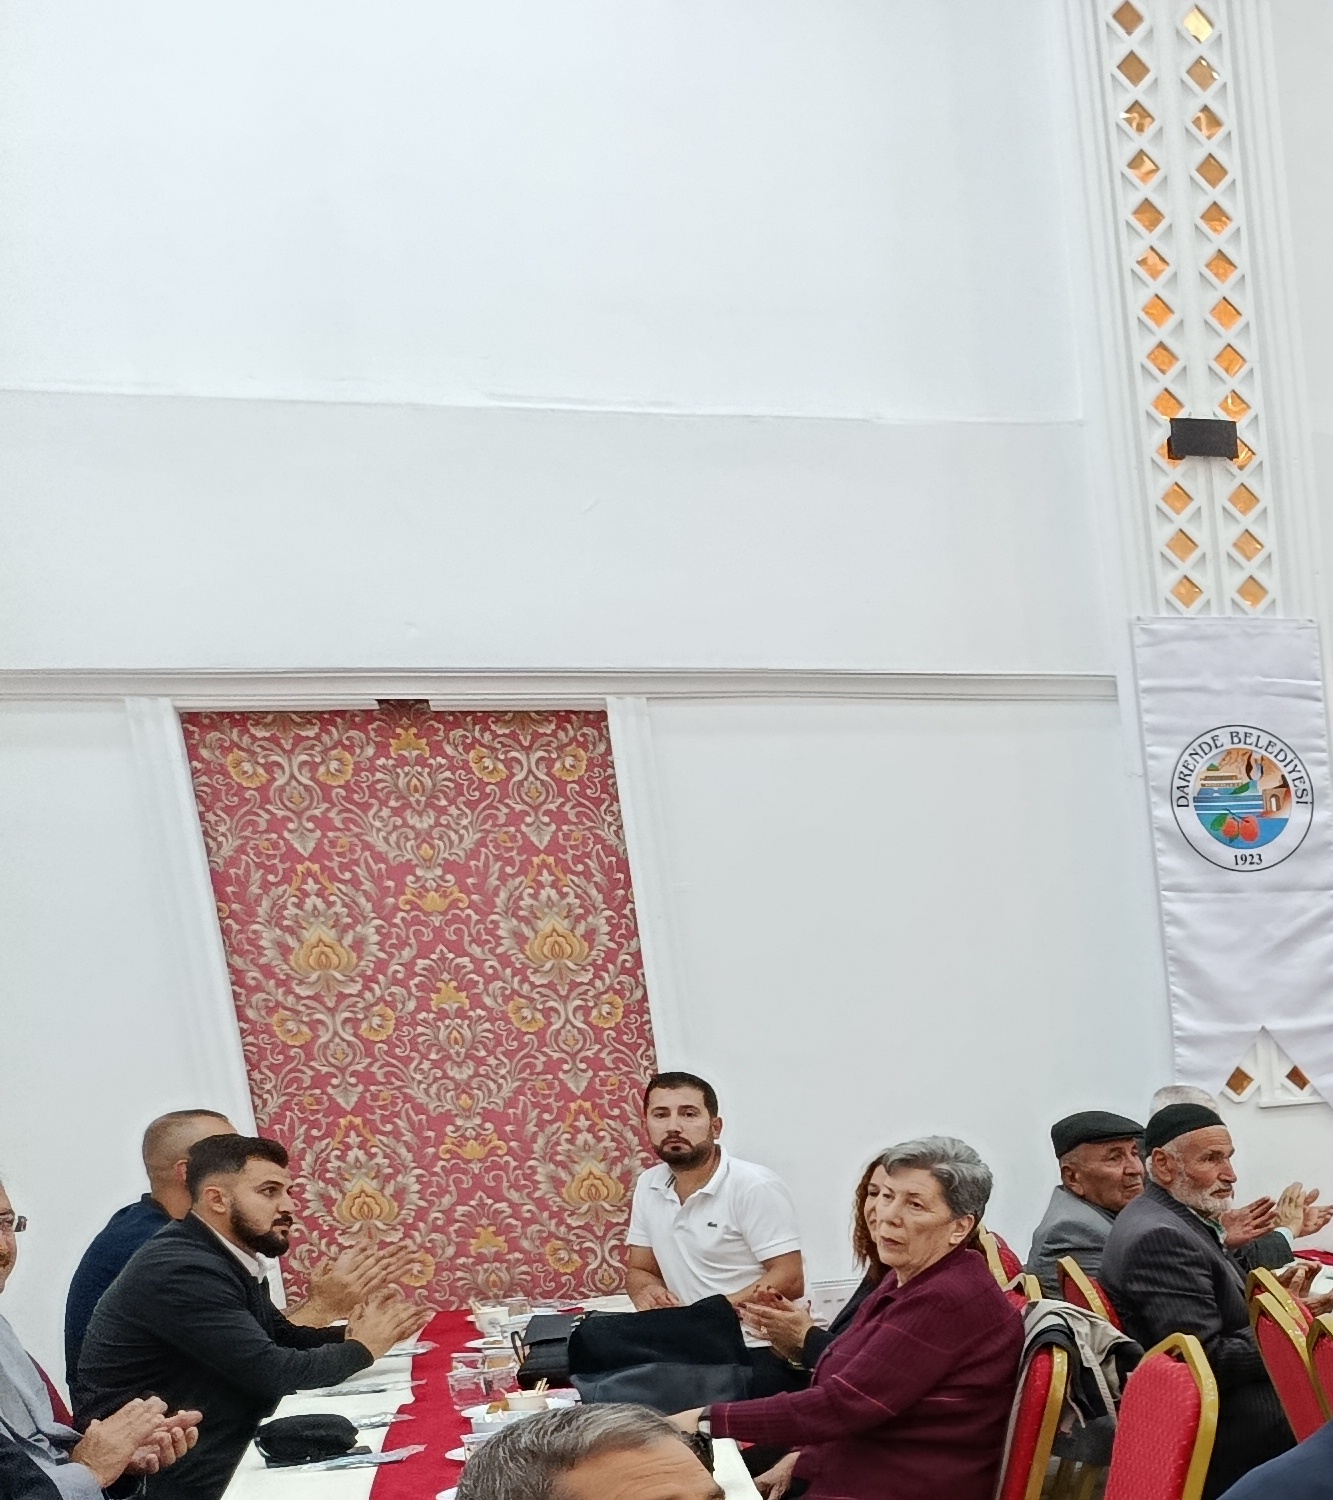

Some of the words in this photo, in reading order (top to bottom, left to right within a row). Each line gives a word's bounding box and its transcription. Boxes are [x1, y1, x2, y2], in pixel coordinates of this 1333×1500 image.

[1176, 734, 1224, 808] DARENDE
[1229, 731, 1313, 805] BELEDİYESİ
[1233, 853, 1263, 866] 1923
